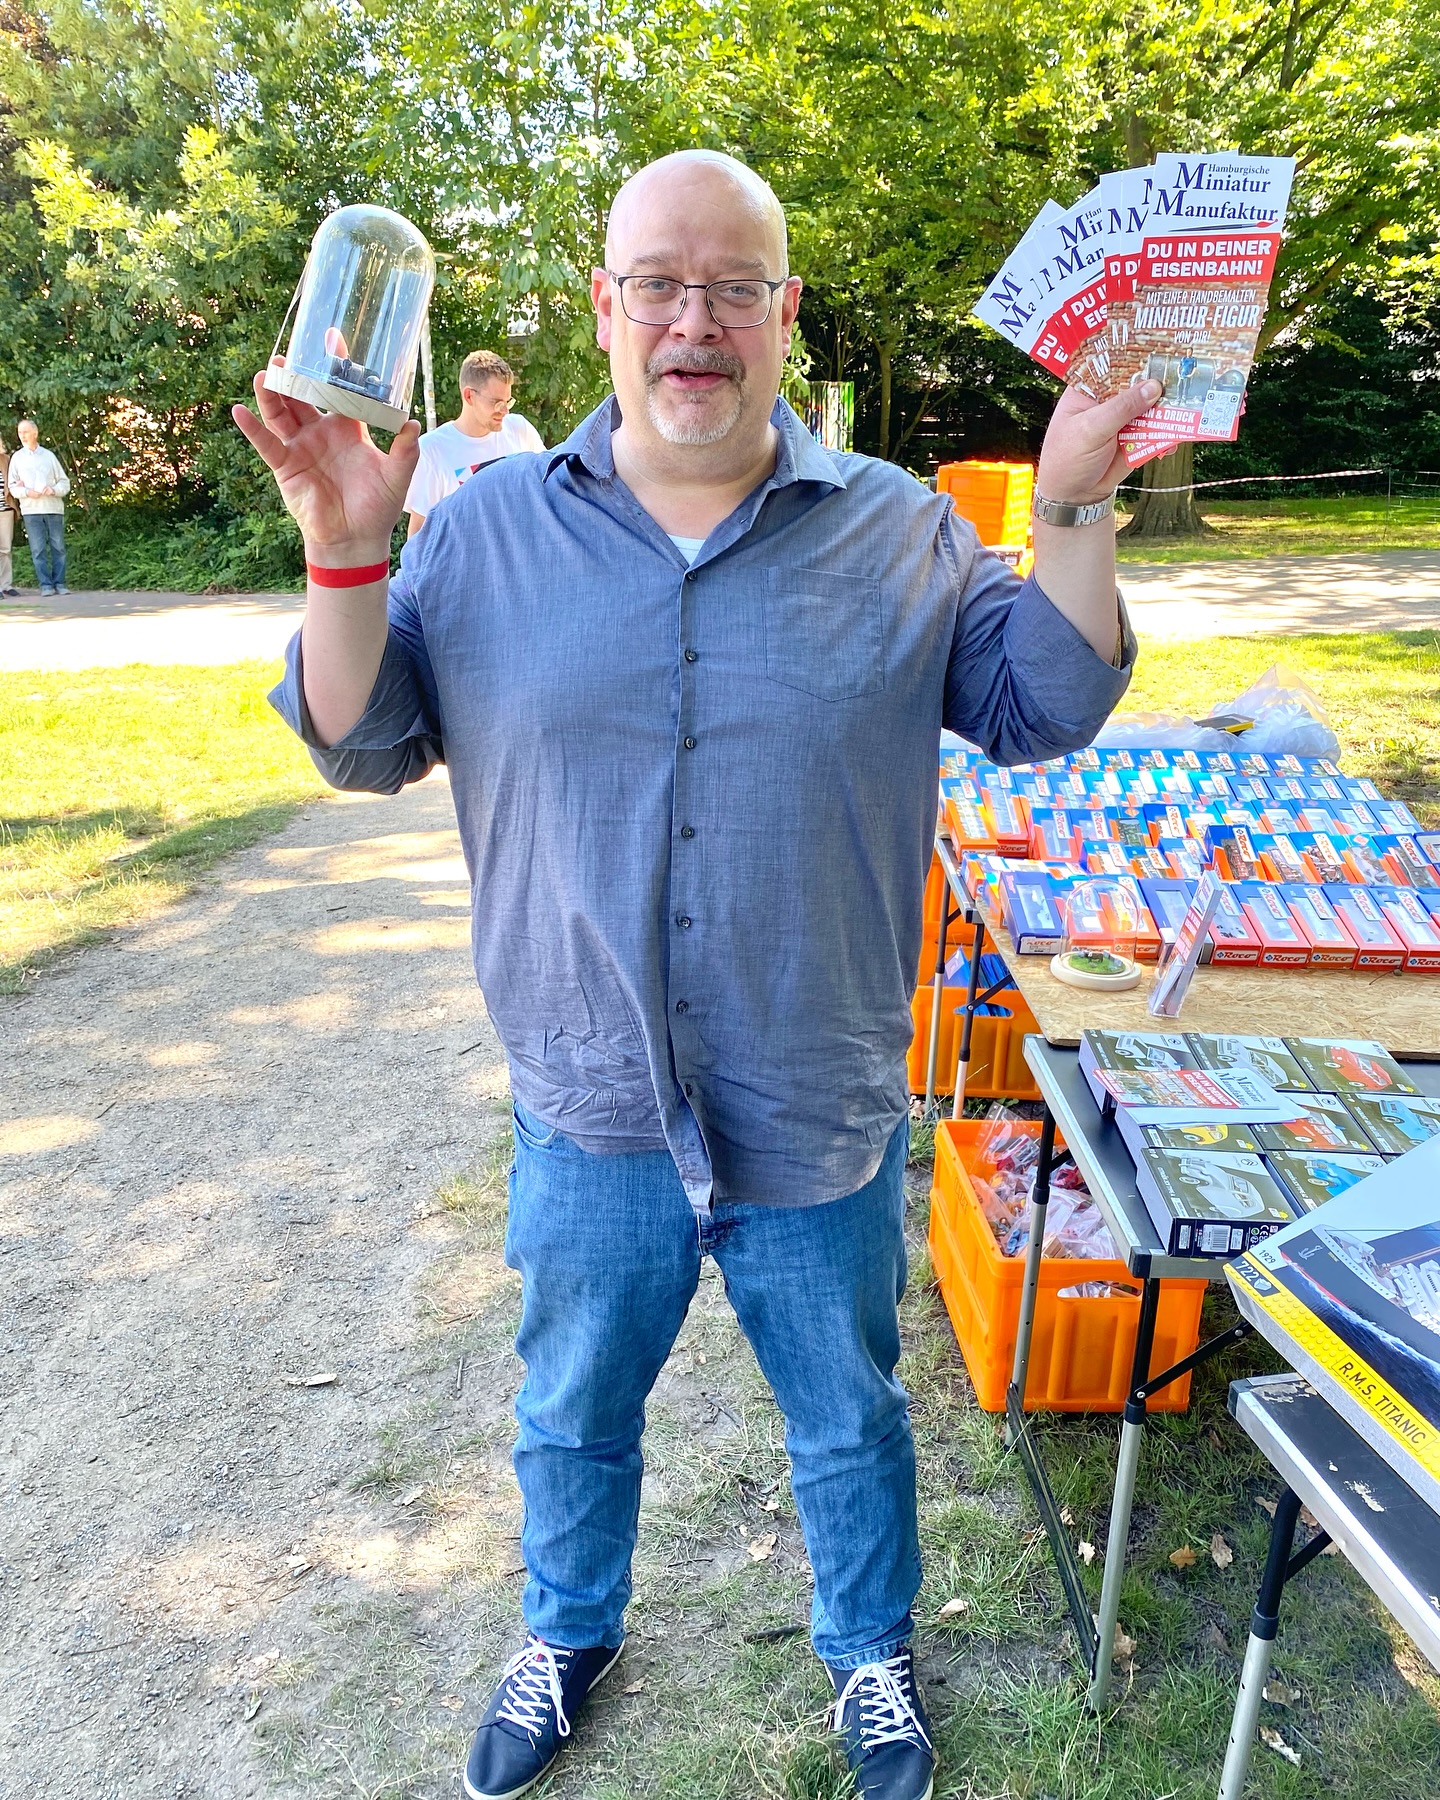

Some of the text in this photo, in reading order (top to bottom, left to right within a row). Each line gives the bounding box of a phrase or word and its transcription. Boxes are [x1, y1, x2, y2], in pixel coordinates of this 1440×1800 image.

[1172, 162, 1271, 193] Miniatur
[1208, 164, 1270, 176] Hamburgische
[1153, 188, 1278, 221] Manufaktur
[1147, 240, 1272, 259] DU IN DEINER
[1151, 260, 1263, 278] EISENBAHN!
[1070, 293, 1096, 317] DU
[1146, 289, 1256, 305] MIT EINER HANDBEMALTEN
[1134, 305, 1260, 329] MINIATUR-FIGUR
[1036, 333, 1058, 360] DU
[1174, 330, 1211, 343] VON DIR!
[1155, 410, 1163, 420] &
[1163, 409, 1196, 423] DRUCK
[1199, 427, 1230, 437] SCAN ME
[1237, 835, 1252, 860] Roco
[1320, 839, 1336, 864] Roco
[1404, 842, 1423, 866] Roco
[1264, 894, 1283, 917] Roco
[1312, 894, 1330, 917] Roco
[1355, 895, 1376, 919] Roco
[1401, 897, 1423, 921] Roco
[1273, 954, 1305, 962] Roco
[1320, 954, 1352, 962] Roco
[1367, 956, 1401, 964] Roco
[1259, 1250, 1276, 1264] 1929
[1235, 1260, 1260, 1282] 722
[1339, 1362, 1426, 1444] R.M.S. TITANIC
